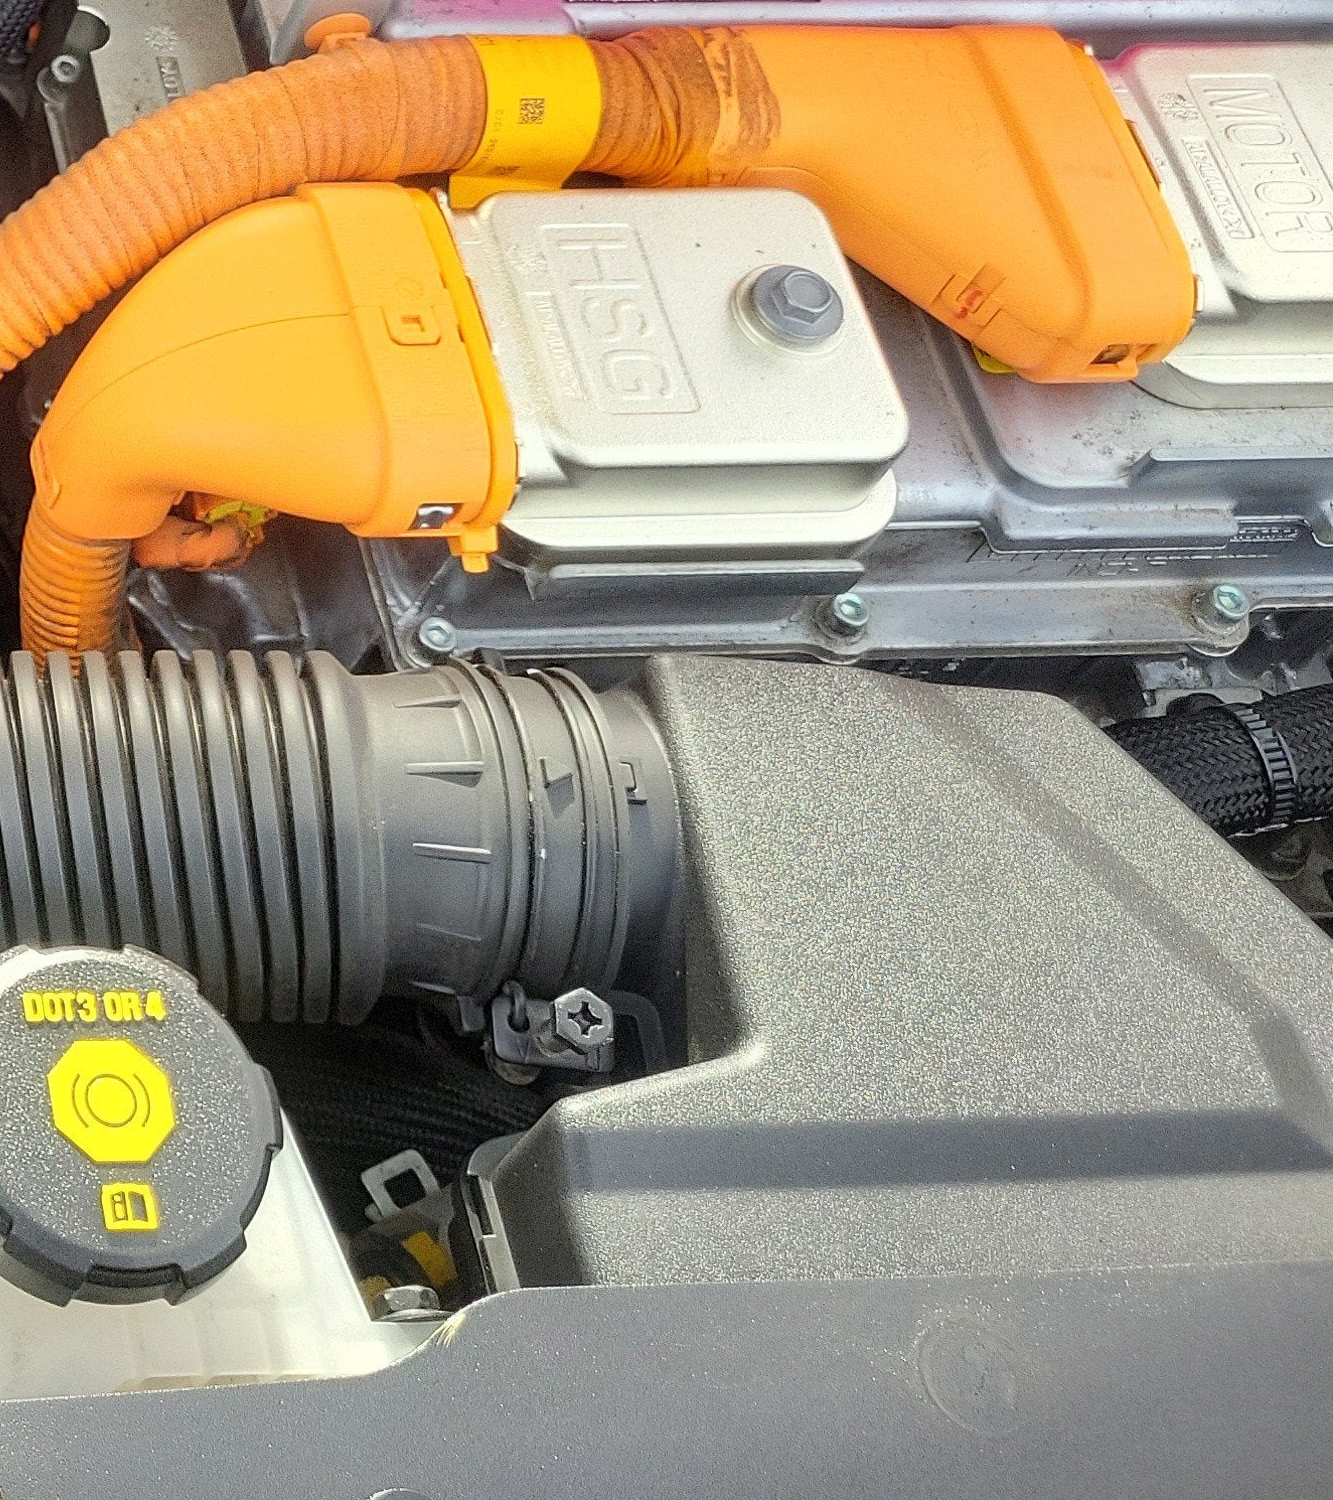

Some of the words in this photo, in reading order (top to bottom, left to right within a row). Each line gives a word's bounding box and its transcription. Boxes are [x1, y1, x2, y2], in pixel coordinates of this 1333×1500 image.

[1202, 87, 1333, 238] MOTOR
[555, 238, 675, 403] HSG
[103, 990, 143, 1022] OR
[145, 989, 166, 1022] 4
